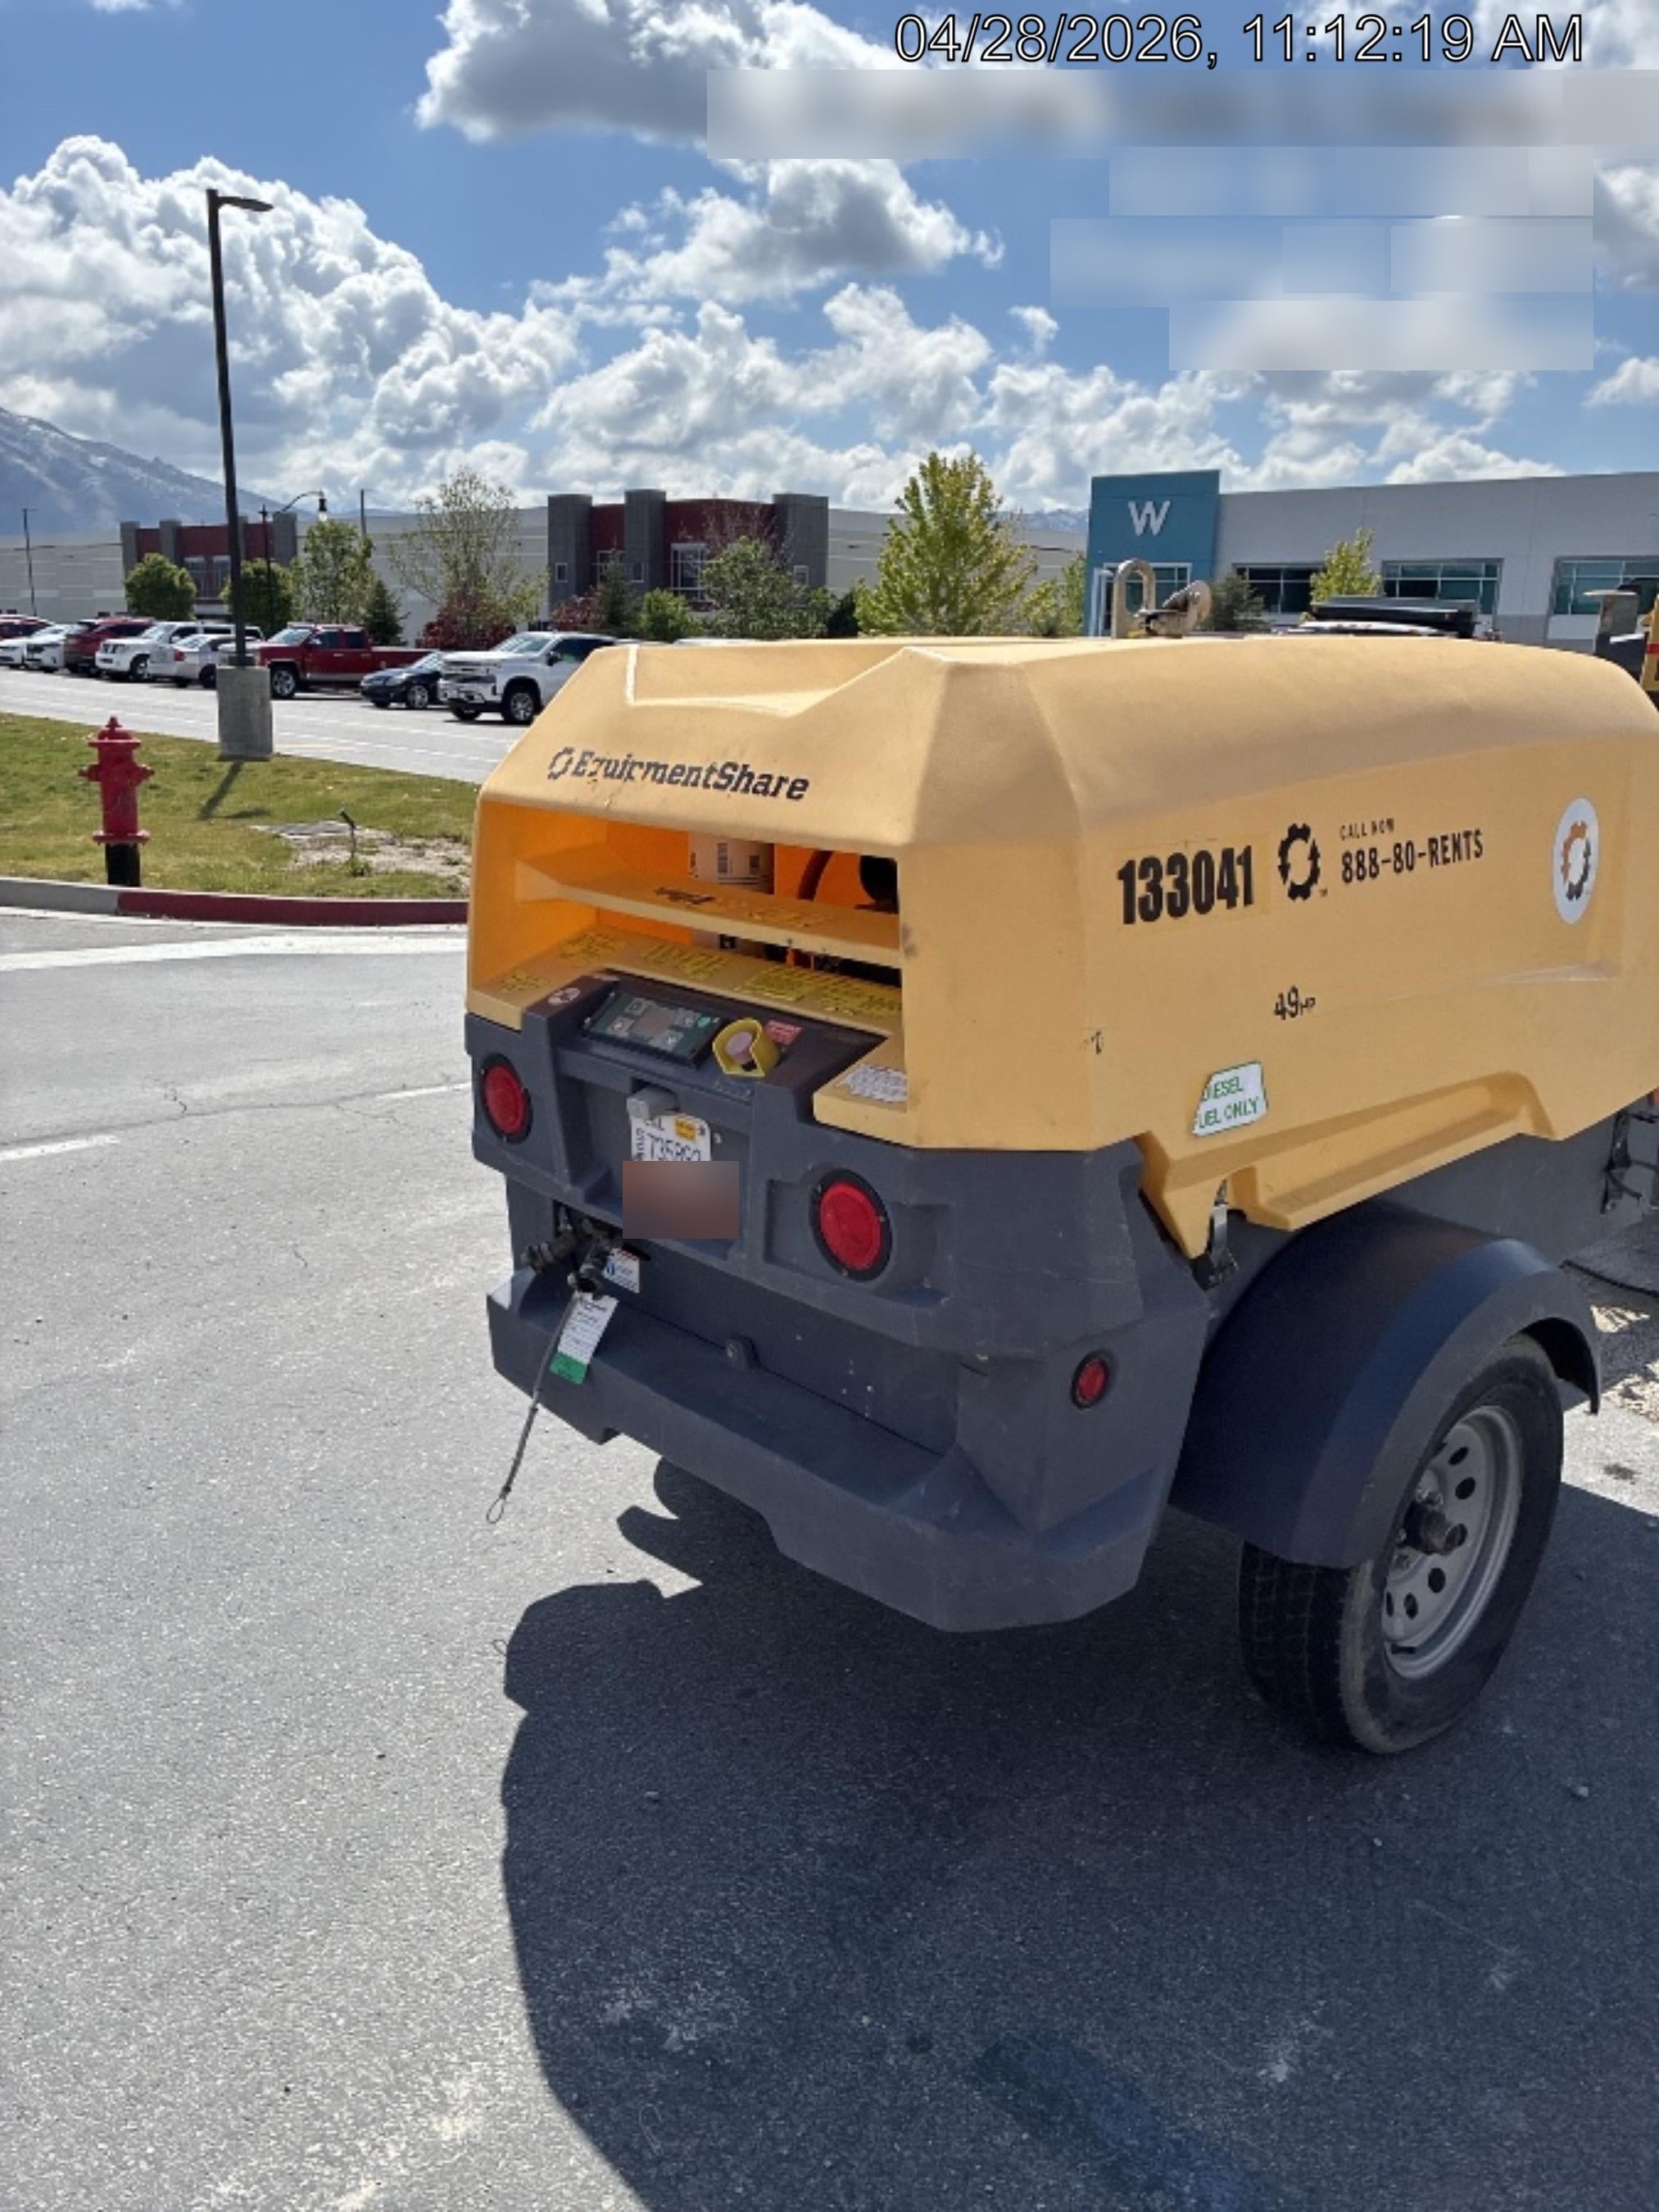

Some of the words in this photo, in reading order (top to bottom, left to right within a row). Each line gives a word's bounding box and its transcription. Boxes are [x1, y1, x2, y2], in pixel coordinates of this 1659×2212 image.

[1127, 501, 1170, 537] W
[1339, 822, 1368, 841] CALL
[1341, 828, 1484, 884] 888-80-RENTS
[1117, 845, 1254, 925] 133041
[1194, 1108, 1222, 1129] UEL
[1224, 1096, 1259, 1119] ONLY
